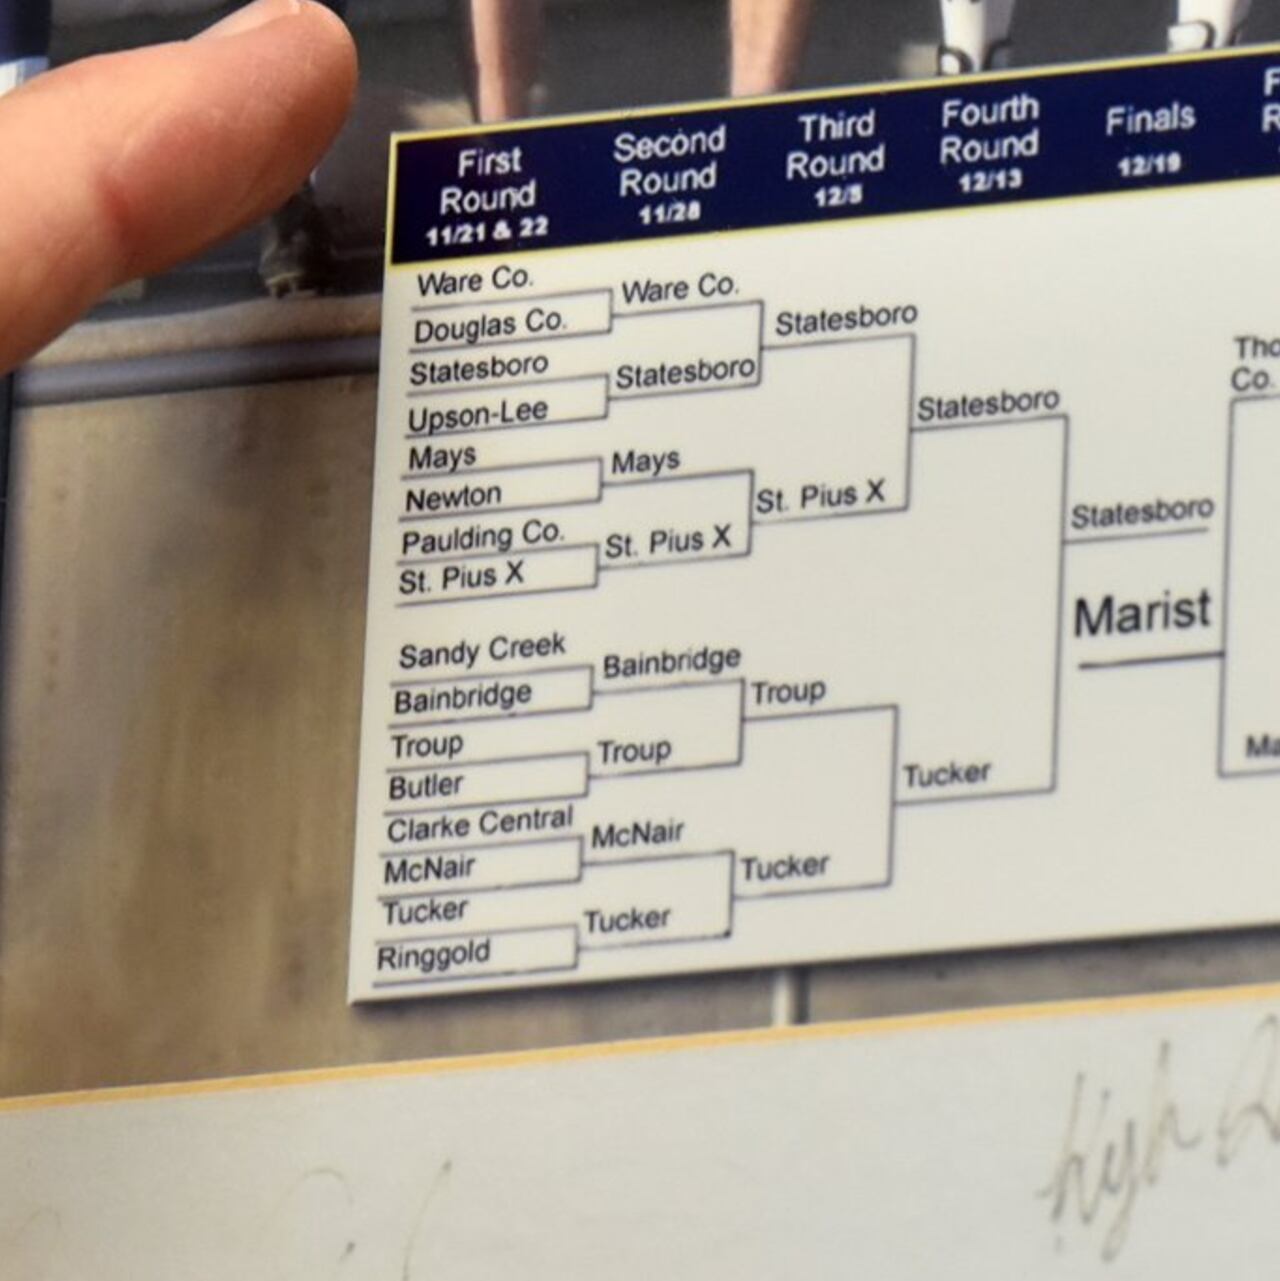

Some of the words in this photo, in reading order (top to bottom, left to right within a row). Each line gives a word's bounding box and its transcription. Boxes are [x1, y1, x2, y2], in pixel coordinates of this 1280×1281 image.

[799, 110, 875, 141] Third
[942, 93, 1039, 128] Fourth
[1106, 102, 1196, 135] Finals
[614, 125, 726, 162] Second
[940, 129, 1039, 164] Round
[458, 147, 522, 177] First
[787, 145, 885, 179] Round
[620, 163, 717, 197] Round
[815, 185, 863, 206] 12/5
[440, 180, 536, 214] Round
[639, 201, 701, 224] 11/28
[426, 224, 485, 246] 11/21
[493, 220, 511, 240] &
[520, 216, 548, 238] 22
[418, 271, 482, 297] Ware
[492, 265, 534, 290] Co.
[622, 278, 689, 305] Ware
[698, 272, 740, 297] Co.
[414, 313, 516, 346] Douglas
[525, 308, 567, 333] Co.
[776, 301, 918, 336] Statesboro
[410, 352, 549, 387] Statesboro
[616, 355, 755, 390] Statesboro
[1231, 365, 1276, 392] Co.
[407, 400, 548, 435] Upson-Lee
[917, 388, 1060, 421] Statesboro
[409, 444, 477, 473] Mays
[612, 450, 681, 478] Mays
[405, 482, 502, 512] Newton
[756, 487, 789, 514] St.
[800, 481, 857, 511] Pius
[865, 478, 885, 502] X
[1072, 496, 1215, 529] Statesboro
[402, 524, 513, 556] Paulding
[522, 520, 565, 544] Co.
[605, 532, 640, 558] St.
[649, 527, 704, 555] Pius
[711, 524, 732, 549] X
[400, 568, 432, 595] St.
[443, 564, 498, 590] Pius
[505, 561, 525, 584] X
[1074, 588, 1212, 639] Marist
[400, 639, 479, 670] Sandy
[489, 631, 567, 662] Creek
[603, 647, 741, 679] Bainbridge
[395, 681, 532, 715] Bainbridge
[751, 679, 826, 707] Troup
[391, 733, 463, 761] Troup
[598, 738, 672, 766] Troup
[389, 771, 463, 801] Butler
[903, 759, 992, 789] Tucker
[388, 813, 470, 844] Clarke
[479, 804, 574, 835] Central
[591, 820, 685, 850] McNair
[383, 855, 475, 885] McNair
[741, 854, 830, 882] Tucker
[383, 897, 468, 927] Tucker
[584, 907, 671, 935] Tucker
[377, 940, 491, 973] Ringgold
